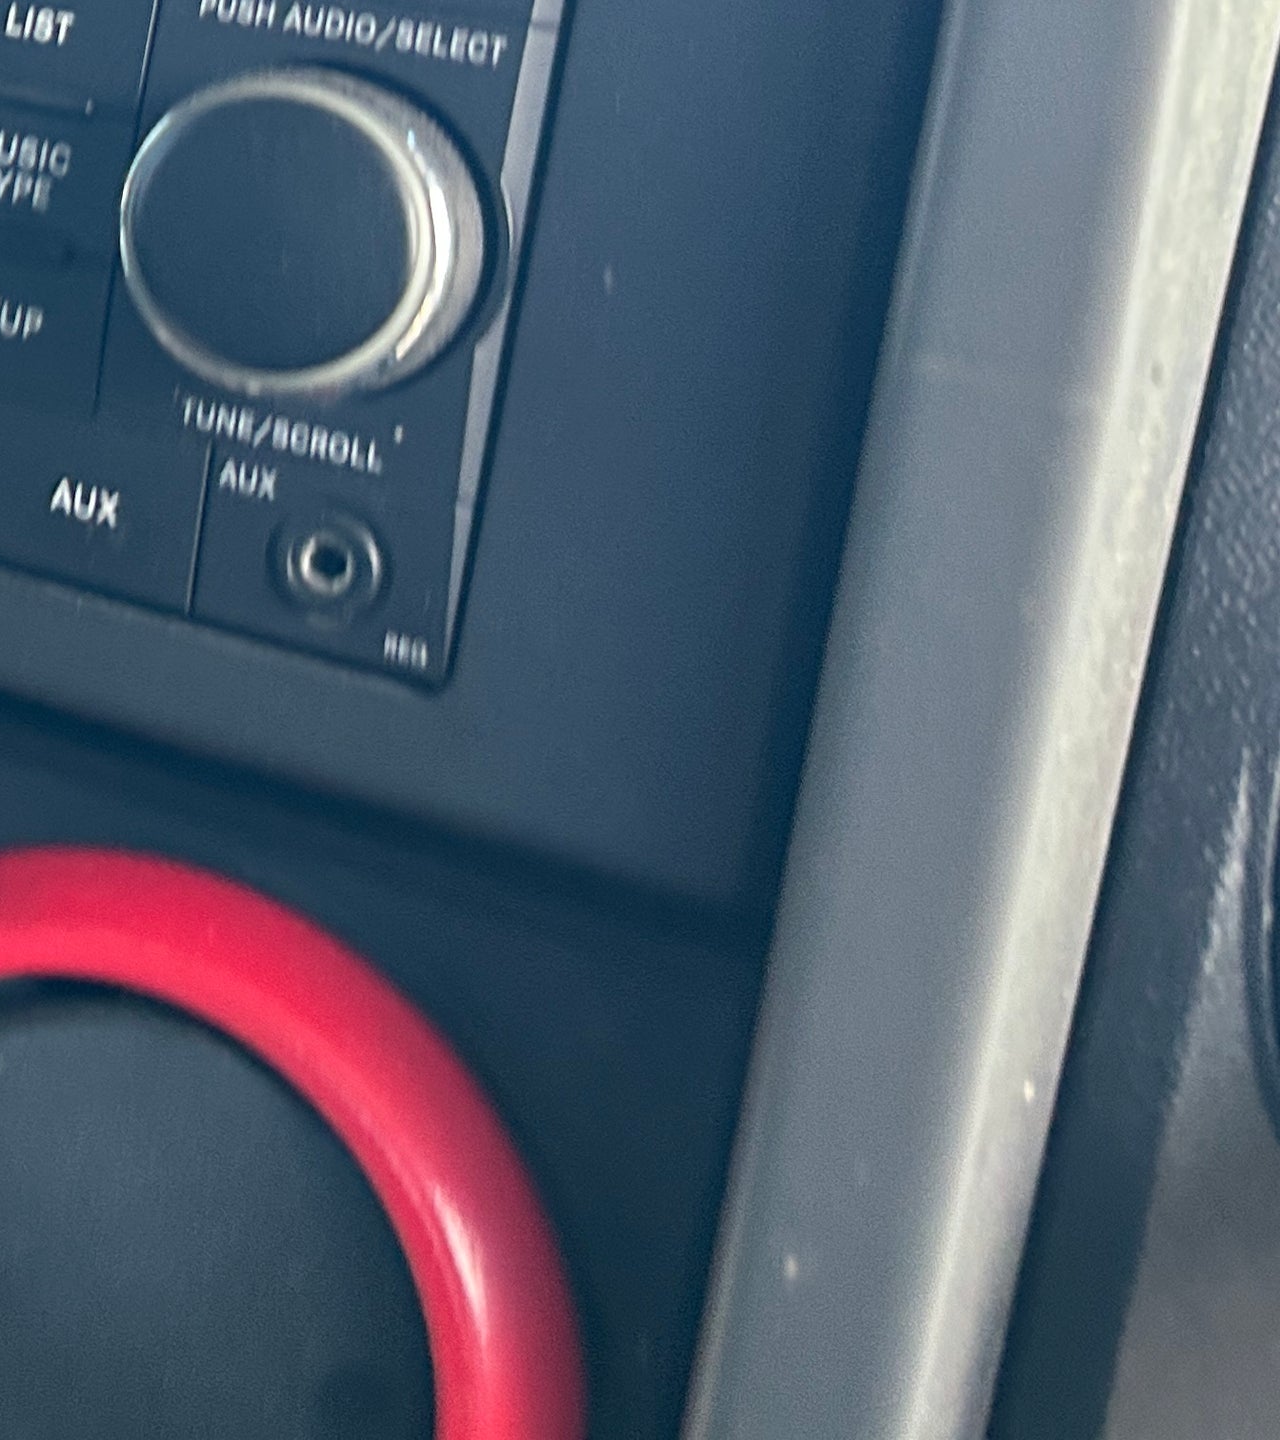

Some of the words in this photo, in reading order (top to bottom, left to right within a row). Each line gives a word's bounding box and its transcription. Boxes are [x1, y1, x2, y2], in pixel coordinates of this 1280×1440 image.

[4, 2, 75, 46] LIST
[282, 0, 507, 70] AUDIO/SELECT
[50, 476, 120, 528] AUX
[219, 458, 277, 502] AUX
